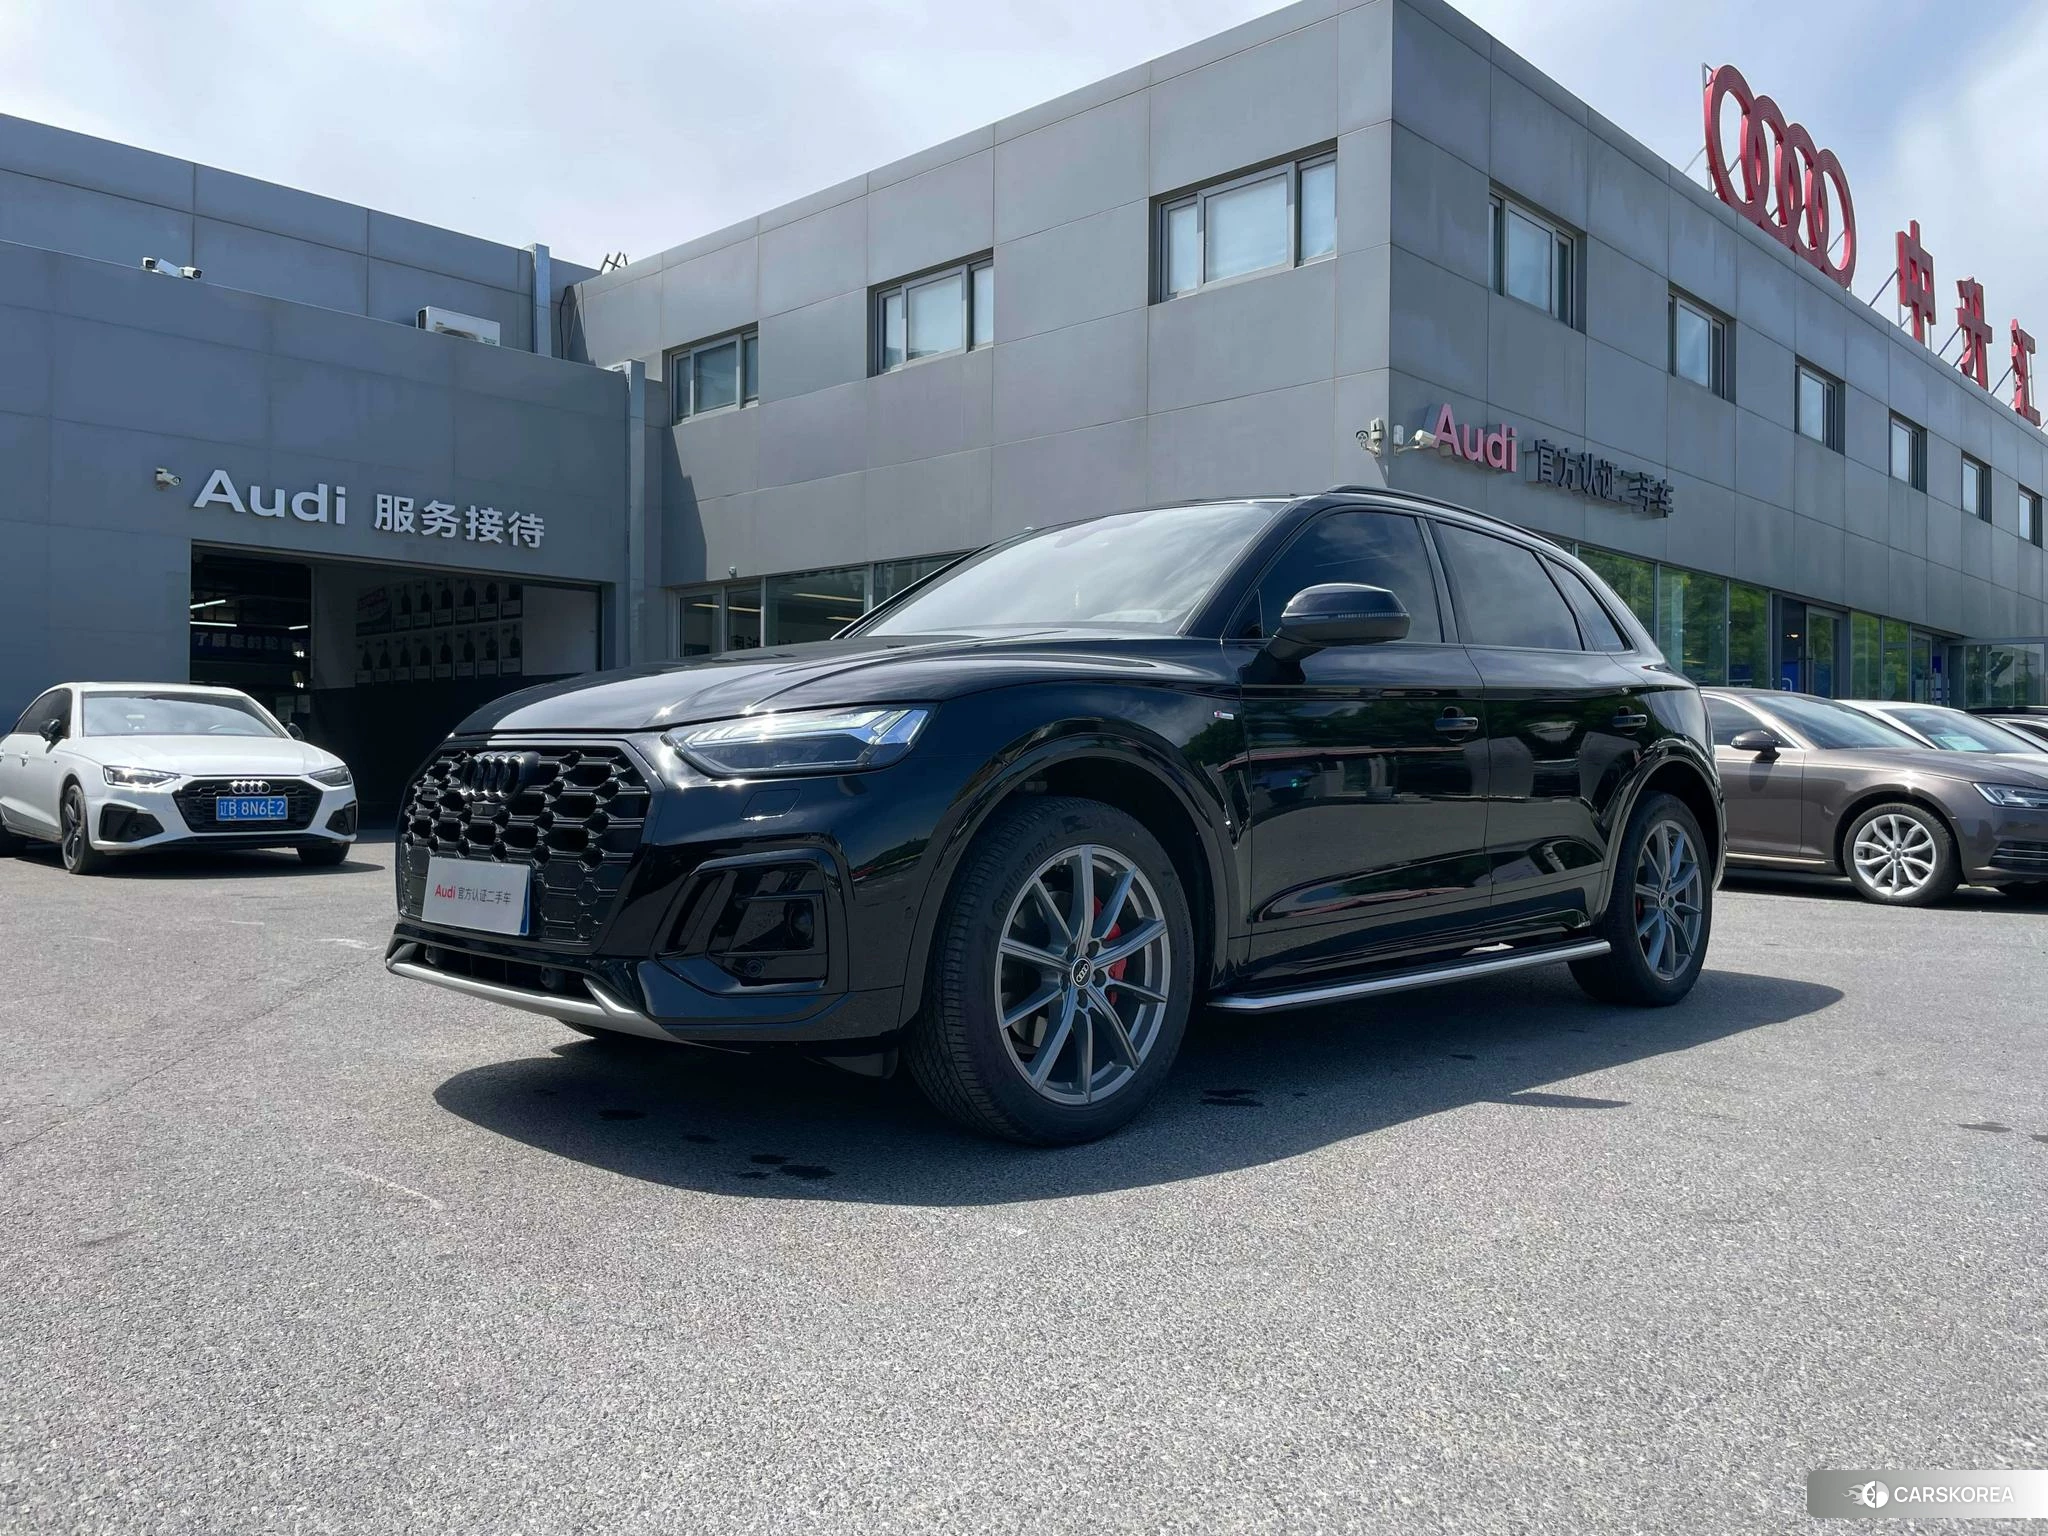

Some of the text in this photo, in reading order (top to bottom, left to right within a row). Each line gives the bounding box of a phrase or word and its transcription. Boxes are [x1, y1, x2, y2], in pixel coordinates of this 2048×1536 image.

[1432, 403, 1674, 518] Audi 官方认证二手车
[193, 469, 545, 549] Audi 服务接待
[434, 883, 512, 905] Audi 官方认证二手车
